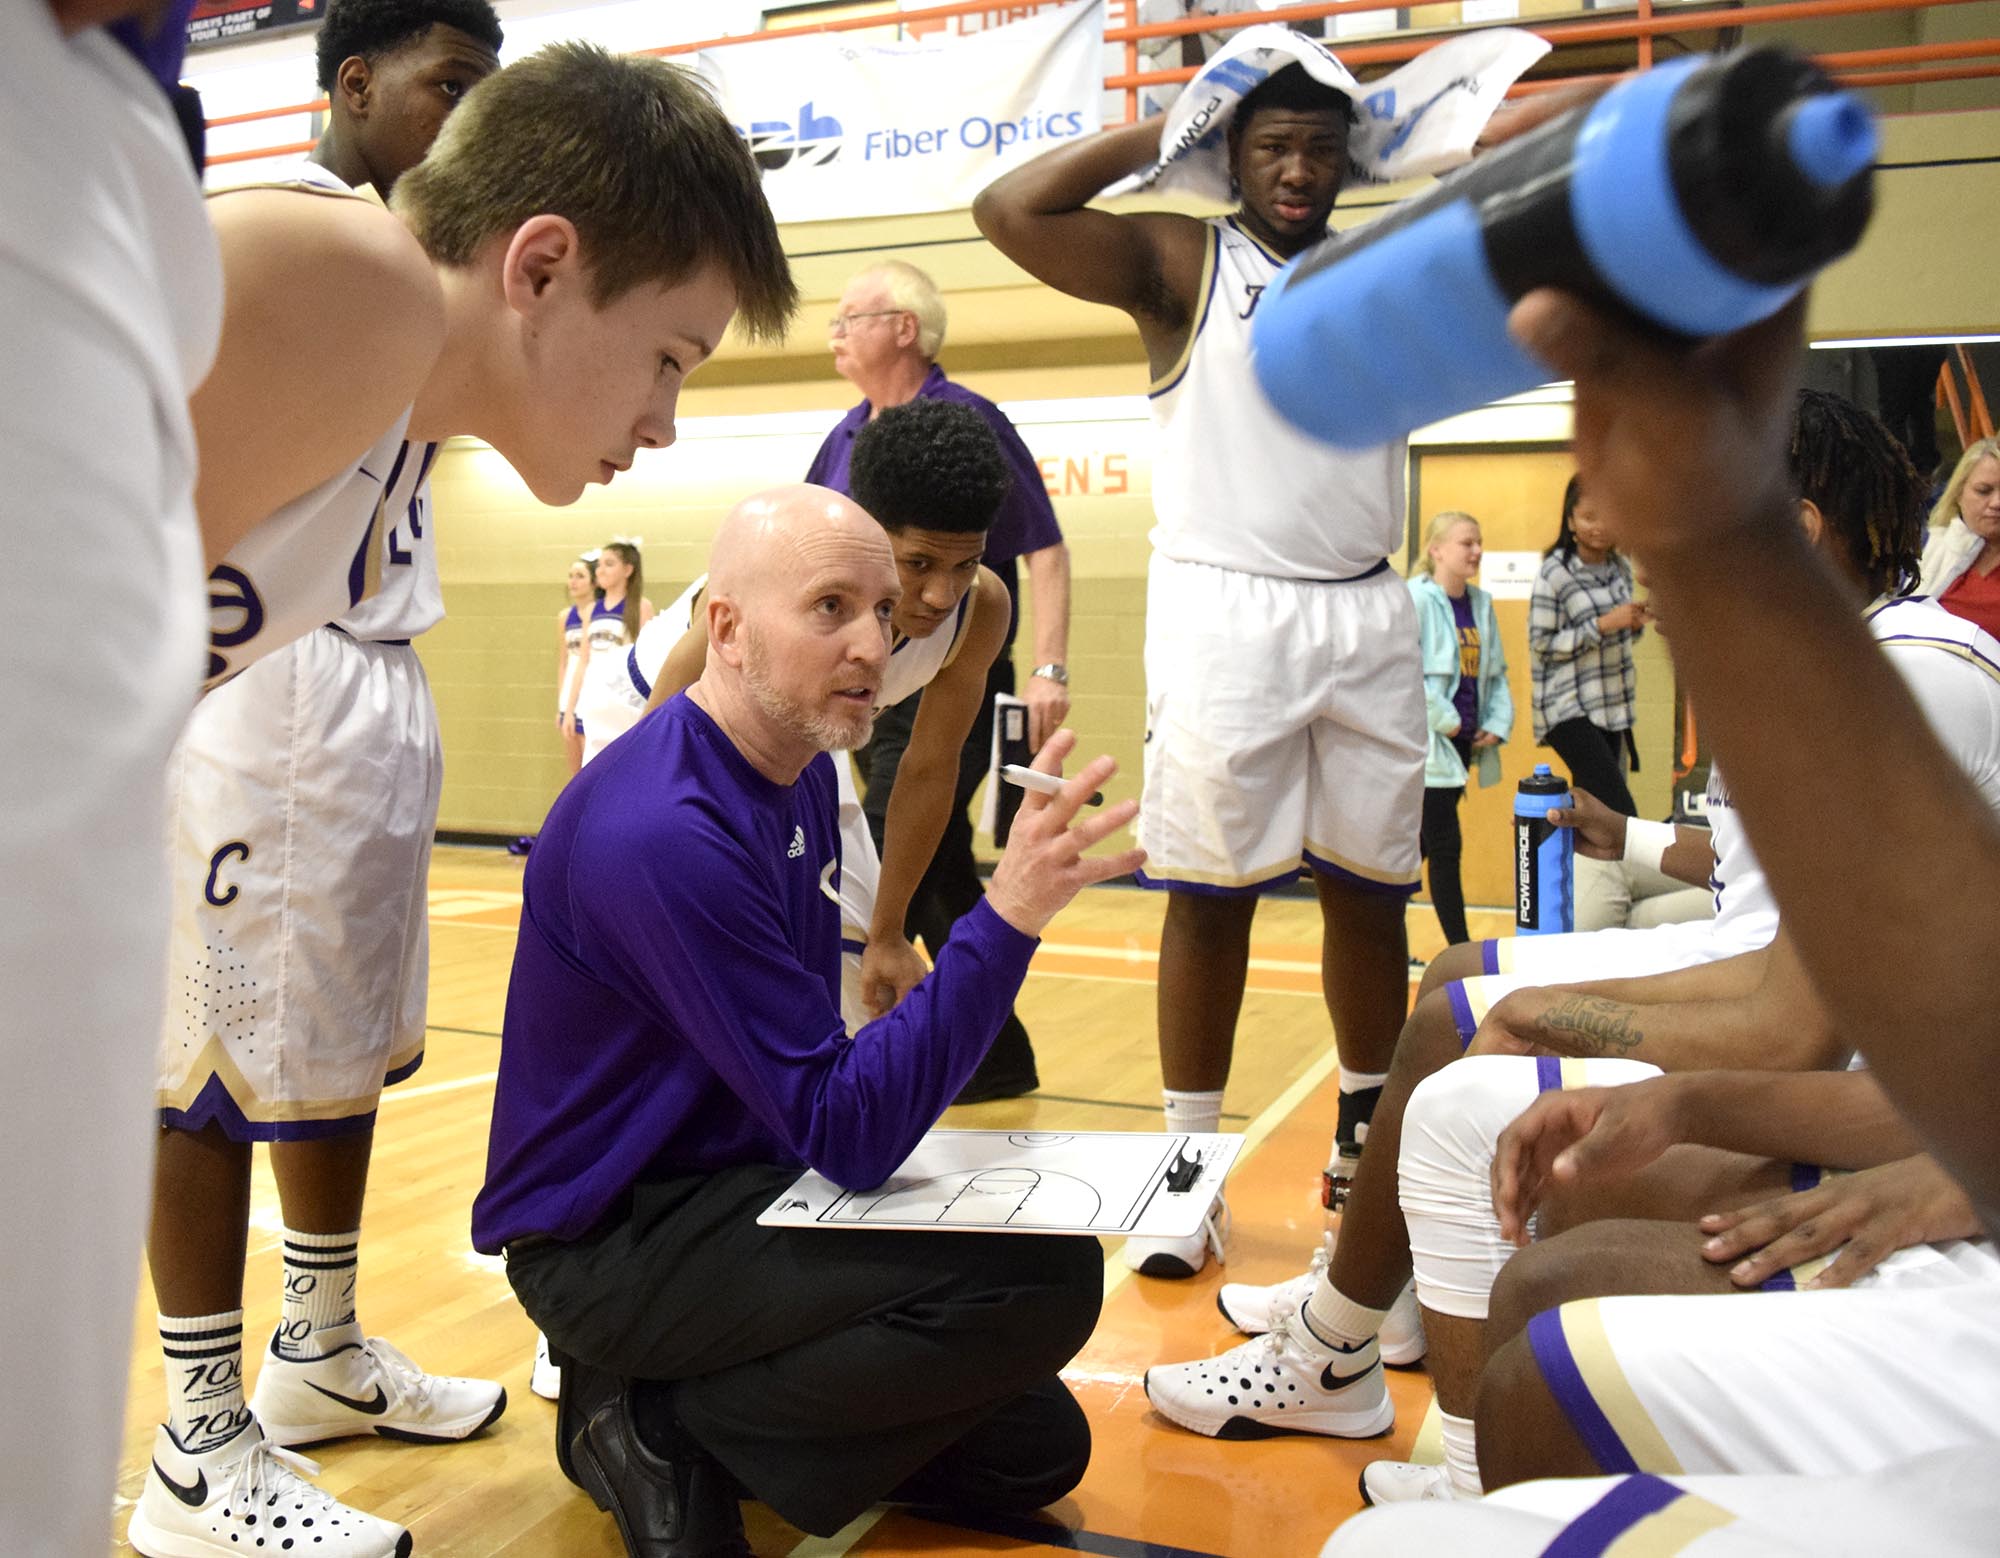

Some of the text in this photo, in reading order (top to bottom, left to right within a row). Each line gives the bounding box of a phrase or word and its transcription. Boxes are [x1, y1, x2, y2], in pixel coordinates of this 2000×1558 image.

[224, 10, 256, 25] PART
[864, 129, 949, 161] Fiber
[960, 111, 1083, 156] Optics
[1519, 824, 1530, 922] POWERADE
